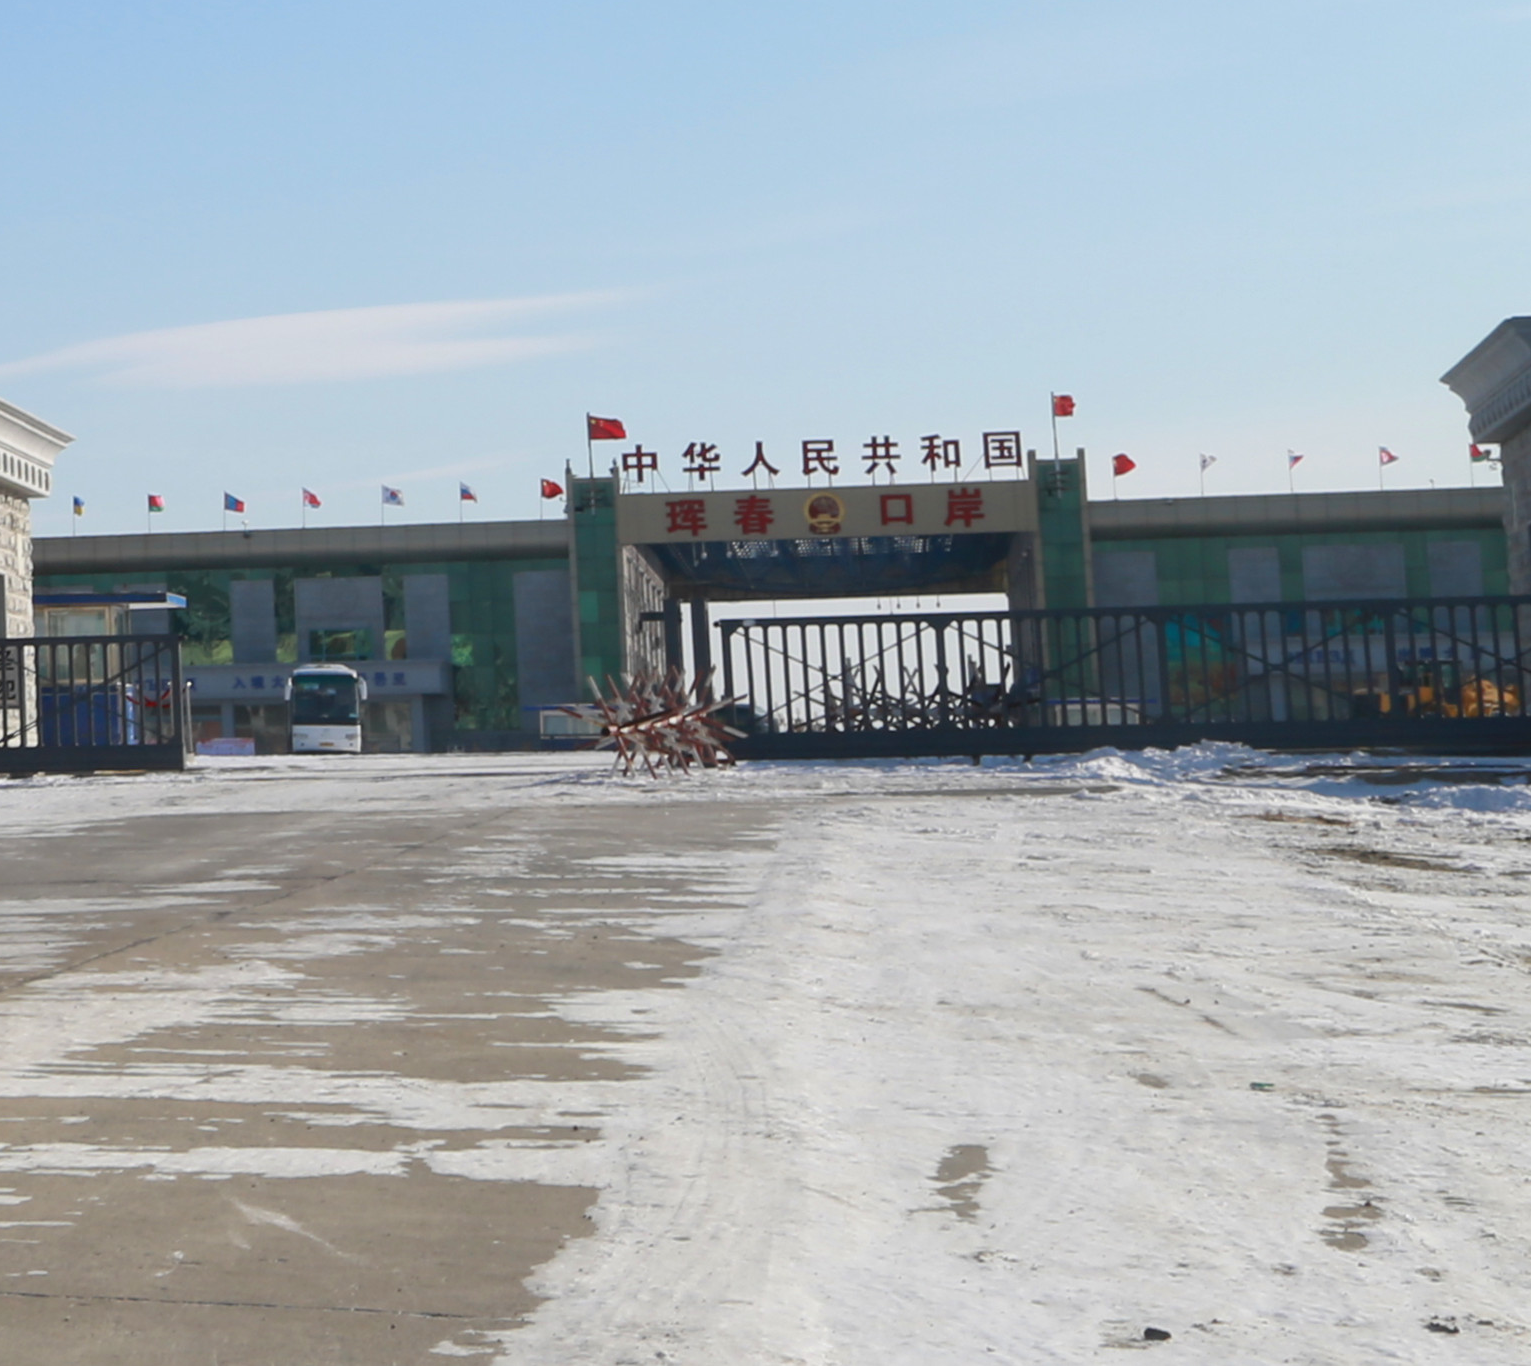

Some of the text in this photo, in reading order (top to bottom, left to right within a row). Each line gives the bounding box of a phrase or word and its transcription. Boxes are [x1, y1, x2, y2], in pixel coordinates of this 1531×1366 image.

[621, 430, 1023, 483] 中华人民共和国
[664, 487, 986, 536] 珲春 口岸
